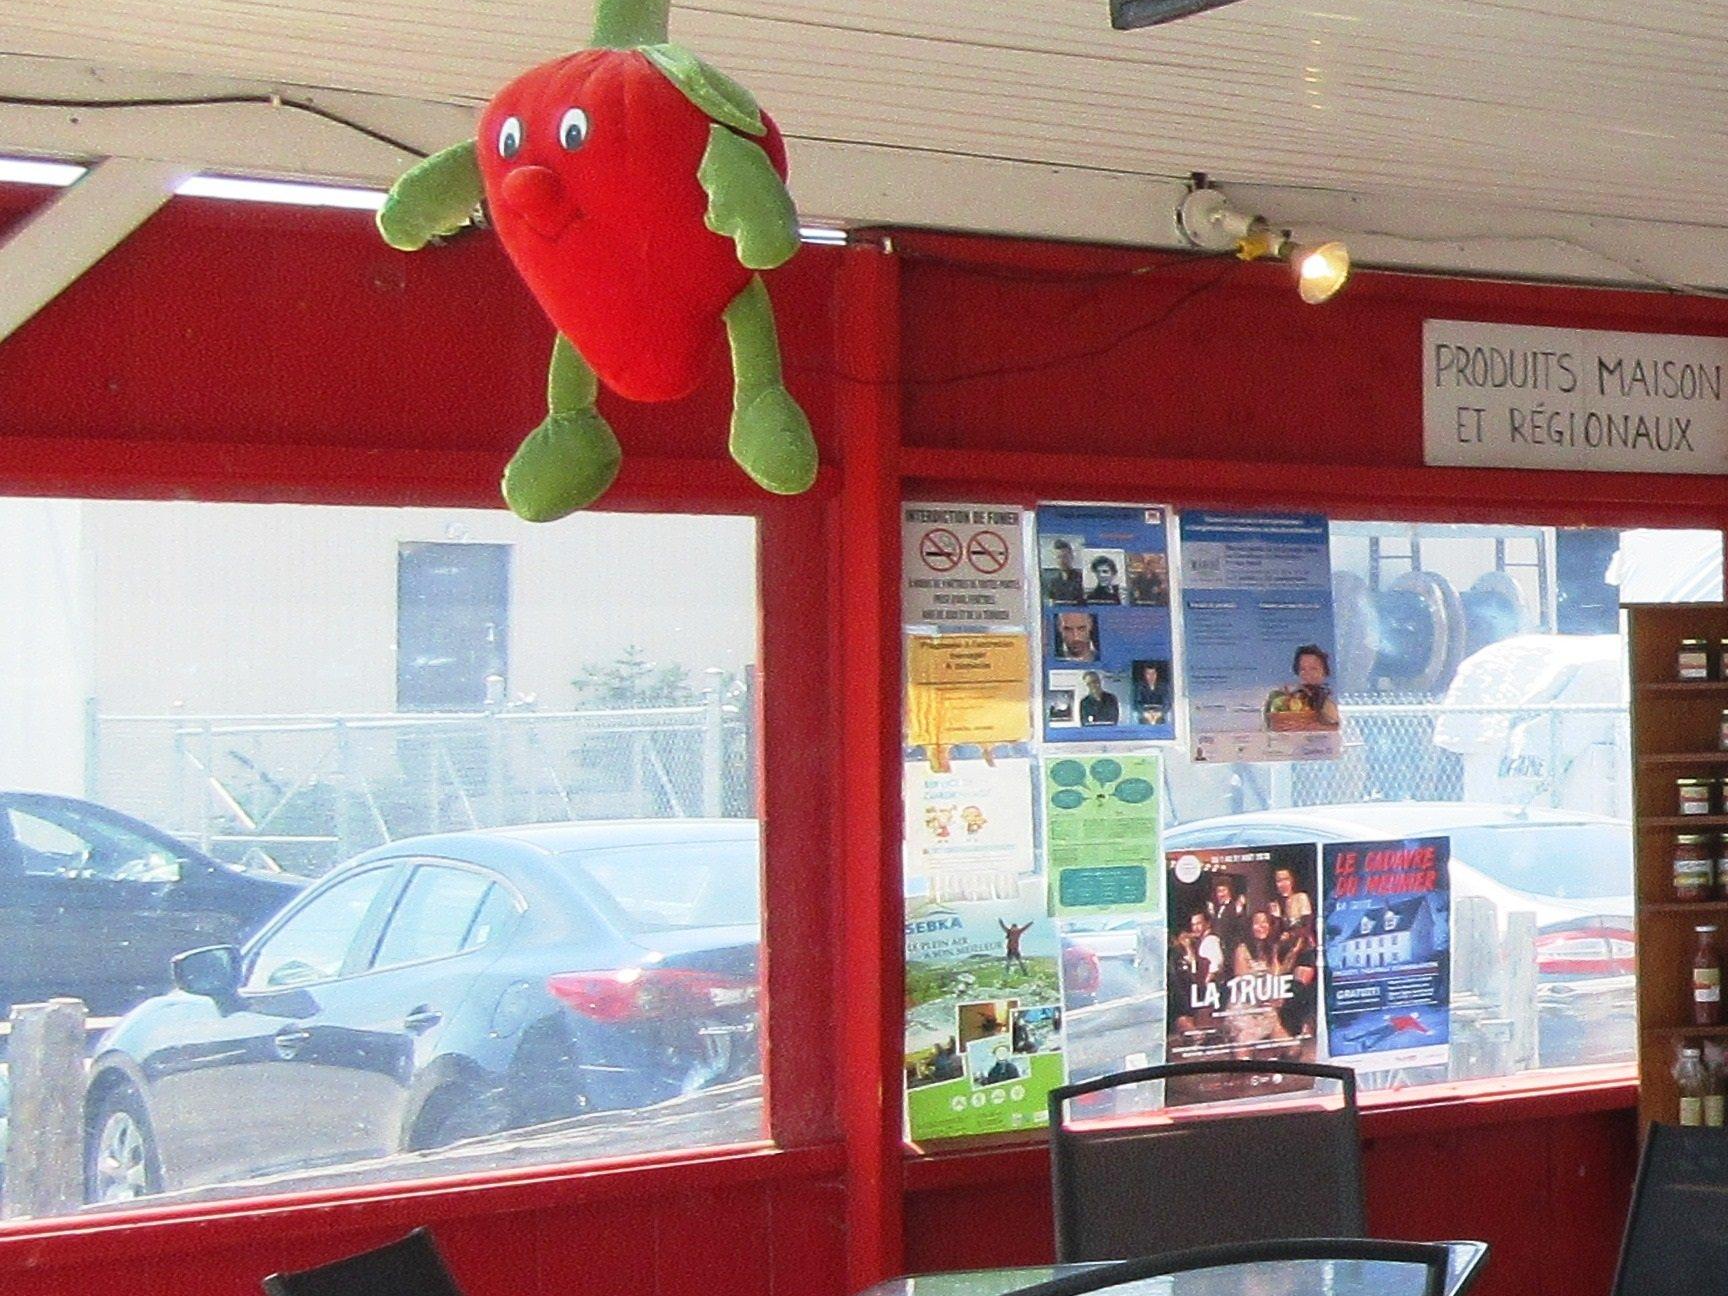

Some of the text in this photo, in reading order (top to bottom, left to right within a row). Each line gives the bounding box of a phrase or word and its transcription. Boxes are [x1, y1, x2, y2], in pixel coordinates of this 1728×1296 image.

[1434, 343, 1721, 401] PRODUITS MAISON
[1456, 402, 1695, 452] ET RÉGIONAUX
[1190, 973, 1294, 1010] LA TRUIE
